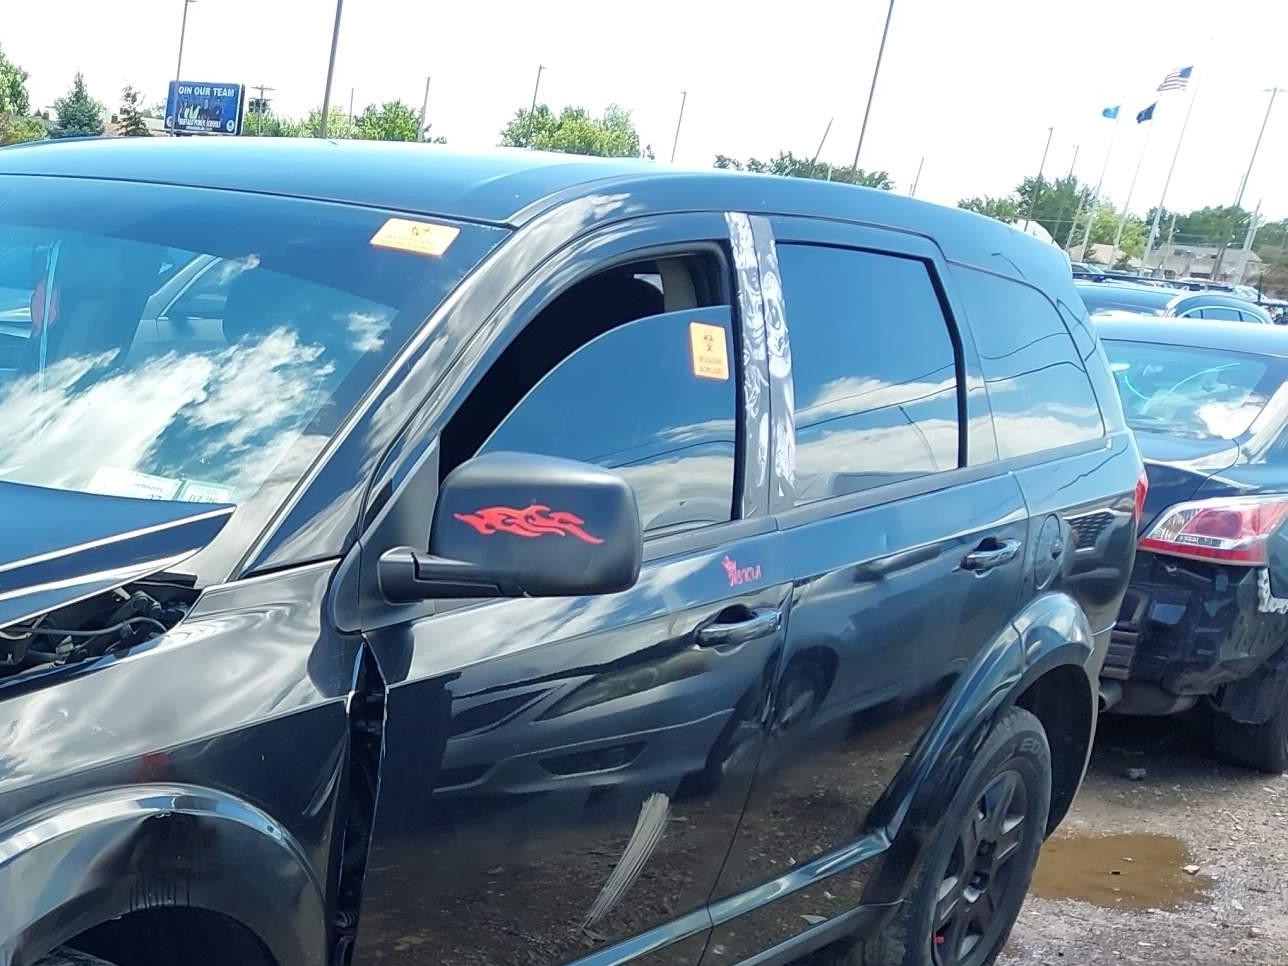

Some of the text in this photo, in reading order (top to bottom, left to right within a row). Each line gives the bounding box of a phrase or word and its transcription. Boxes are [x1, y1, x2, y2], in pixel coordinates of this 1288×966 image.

[178, 86, 235, 97] OIN OUR TEAM
